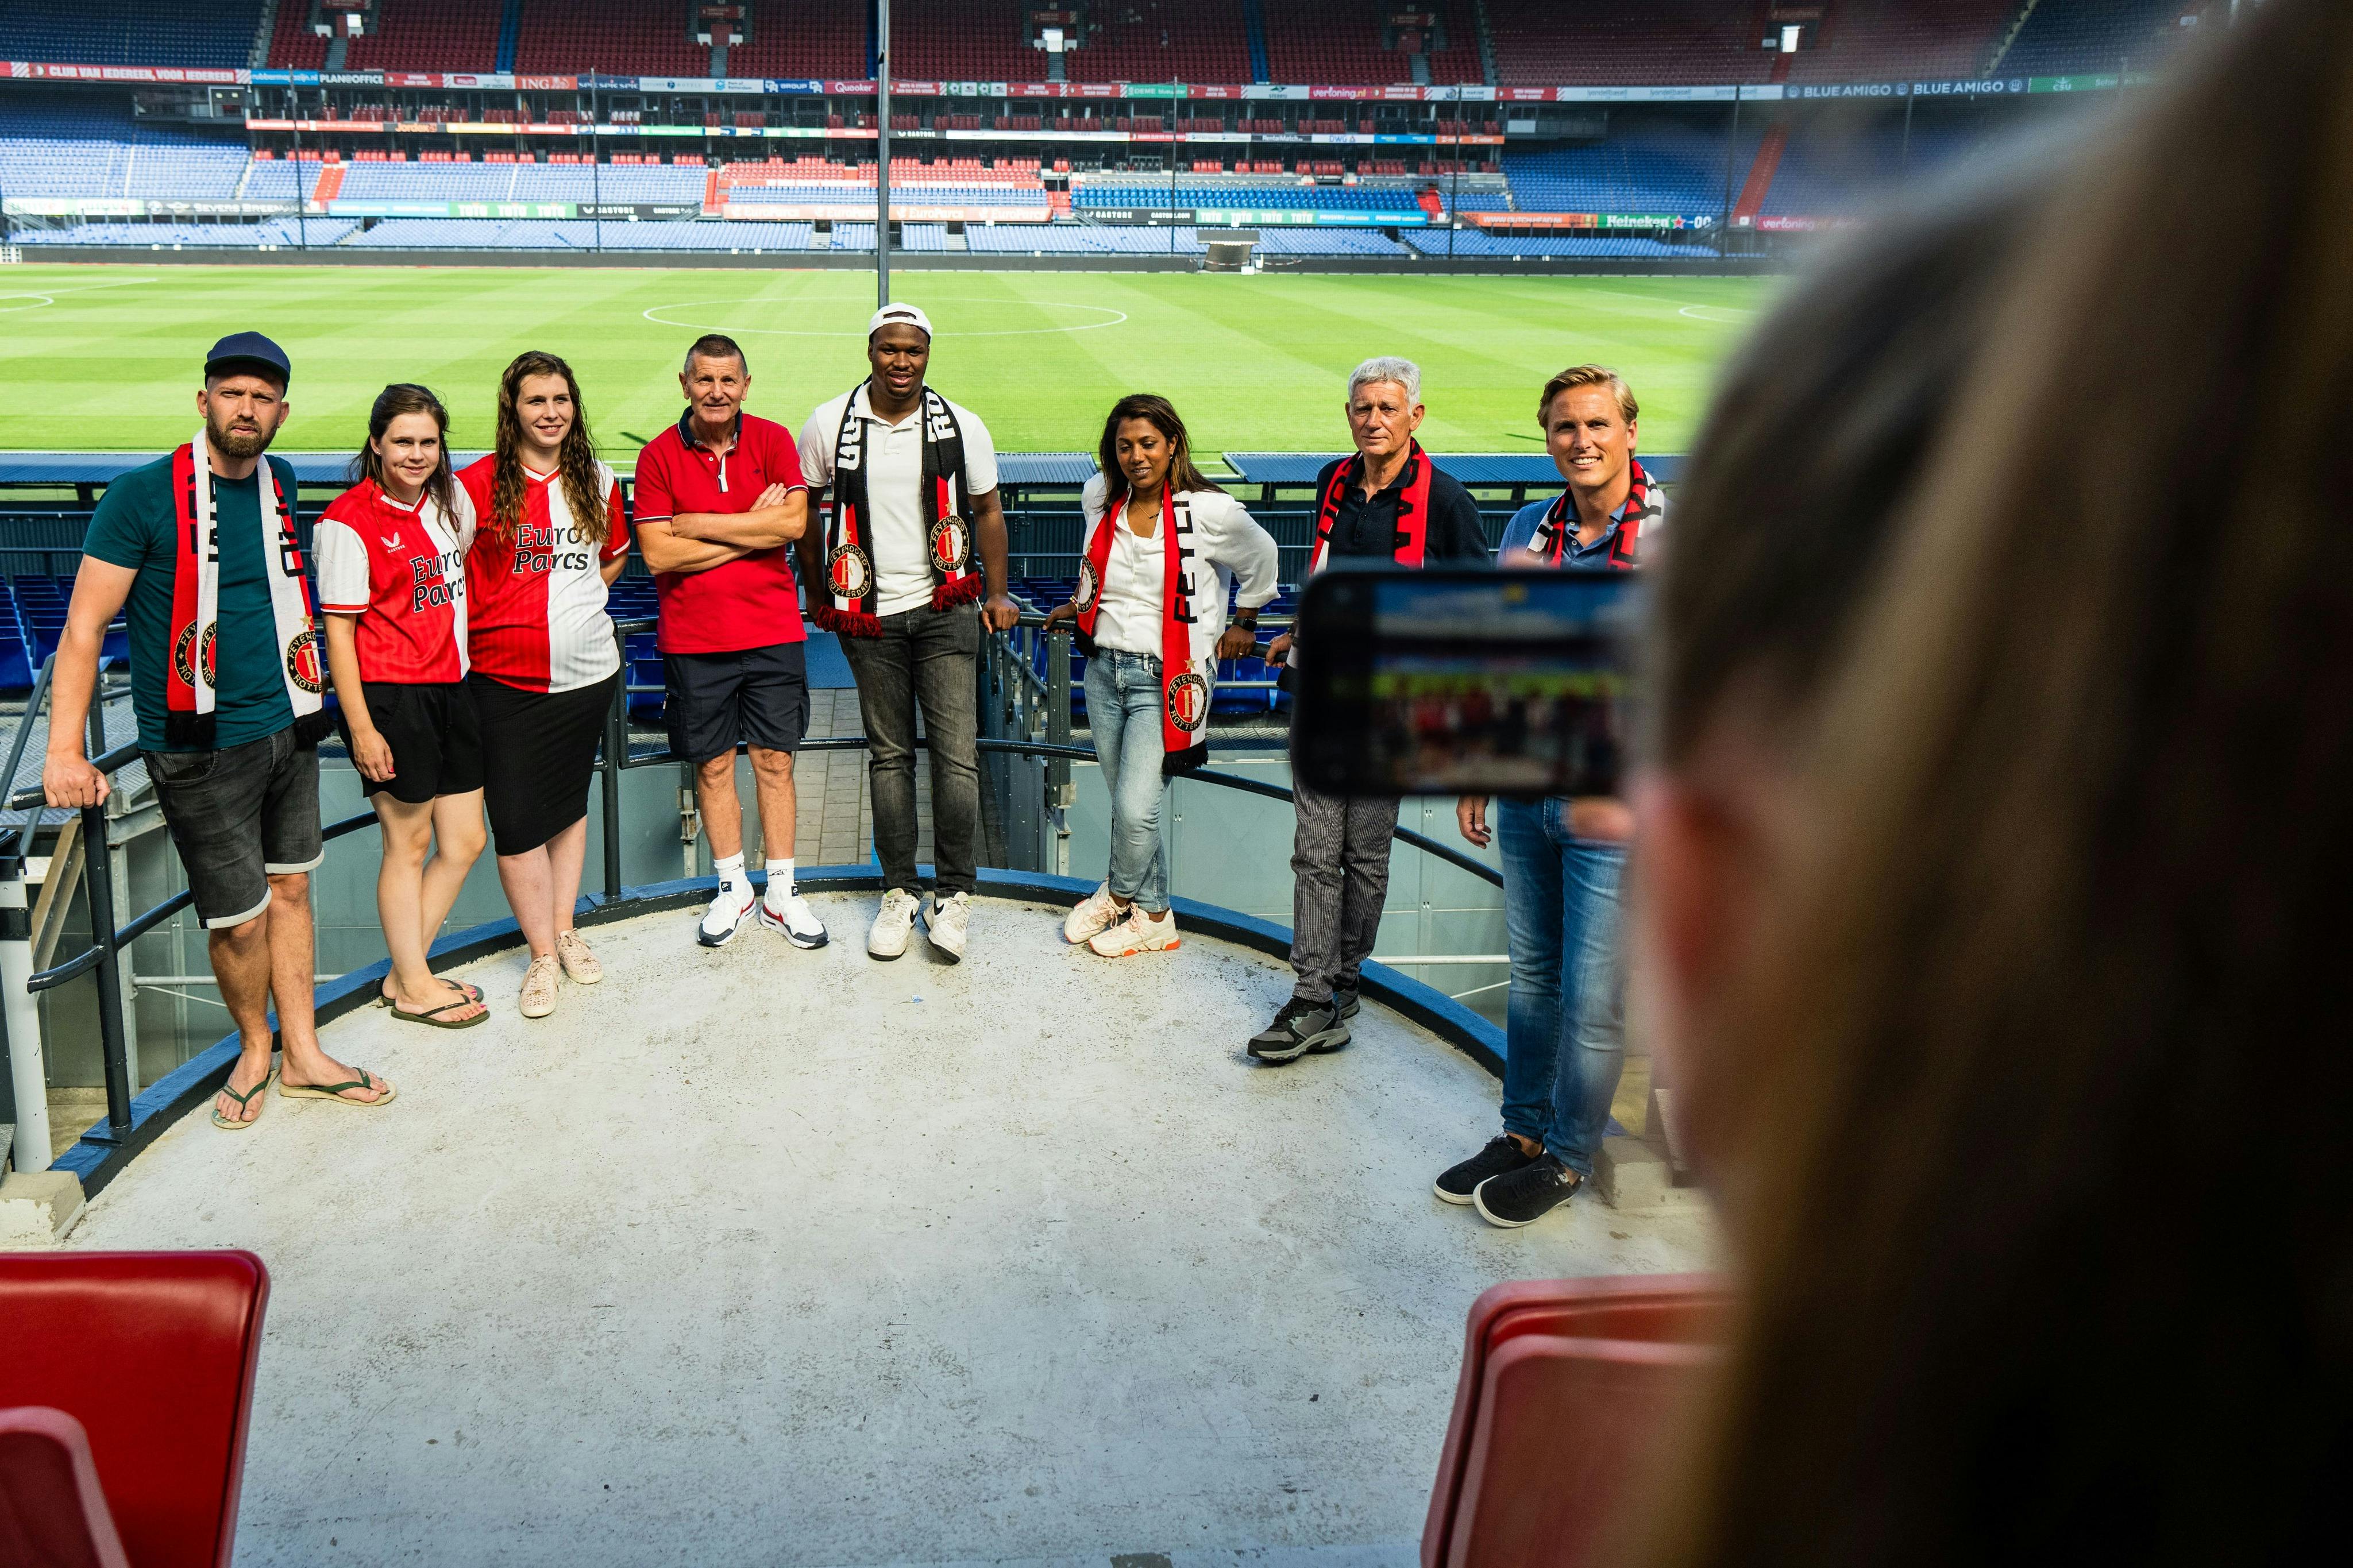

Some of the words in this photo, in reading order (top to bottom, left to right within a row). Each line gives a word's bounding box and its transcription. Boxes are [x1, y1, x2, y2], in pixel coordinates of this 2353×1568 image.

[49, 66, 78, 77] CLUB
[78, 67, 102, 78] VAN
[156, 69, 184, 80] VOOR
[185, 70, 234, 82] IEDEREEN
[522, 79, 550, 89] ING
[835, 82, 873, 93] Quooker
[1313, 86, 1367, 99] verloning.nl
[1804, 86, 1839, 97] BLUE
[1842, 84, 1891, 96] AMIGO
[1913, 83, 1950, 95] BLUE
[1953, 81, 2004, 93] AMIGO
[1096, 211, 1132, 219] CASTORE
[1606, 215, 1670, 227] Heineken
[515, 523, 581, 549] Euro
[932, 517, 965, 542] FEYENOORD
[512, 550, 589, 574] Parcs
[829, 545, 869, 566] FEYENOORD
[934, 546, 967, 570] ROTTERDAM
[409, 549, 461, 585] Euro
[414, 576, 465, 613] Parc
[1170, 674, 1207, 696] FEYENOORD
[1170, 706, 1206, 730] ROTTERDAM
